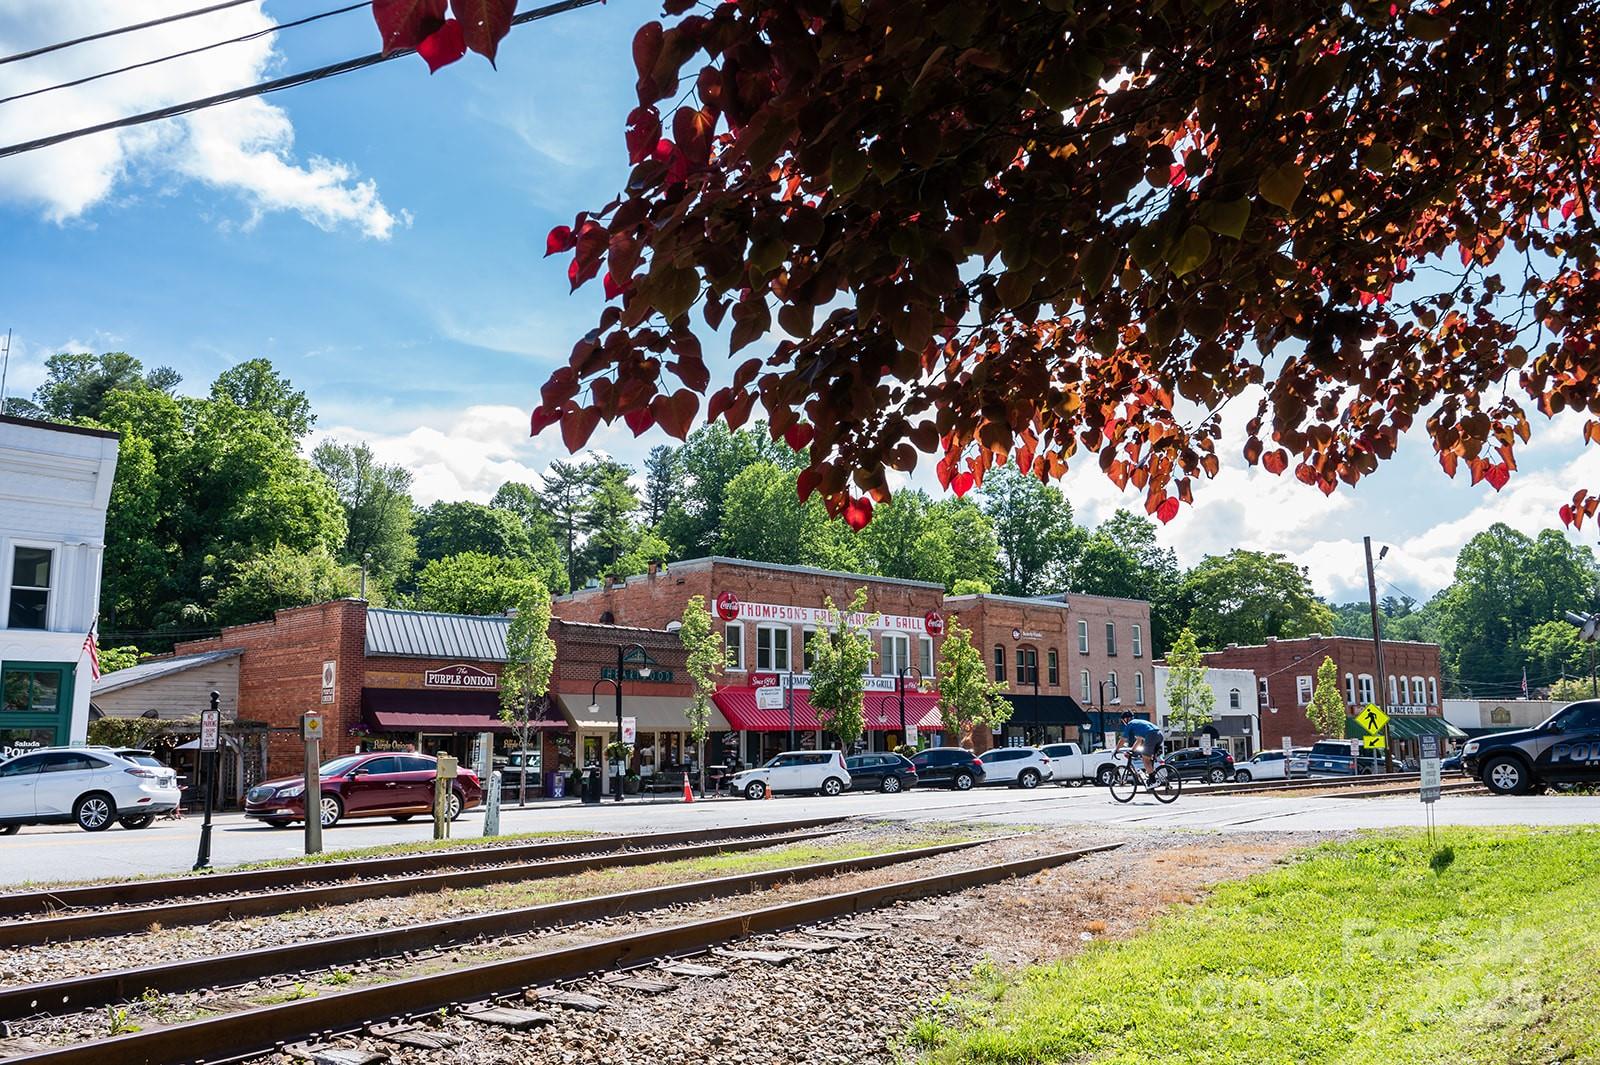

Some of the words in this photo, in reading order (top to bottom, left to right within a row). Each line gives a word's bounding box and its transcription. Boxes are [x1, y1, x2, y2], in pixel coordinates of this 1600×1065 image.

[740, 603, 808, 620] THOMPSON'S
[884, 615, 891, 627] &
[896, 617, 923, 630] GRILL
[428, 673, 462, 685] PURPLE
[463, 675, 494, 686] ONION
[876, 679, 893, 690] GRILL
